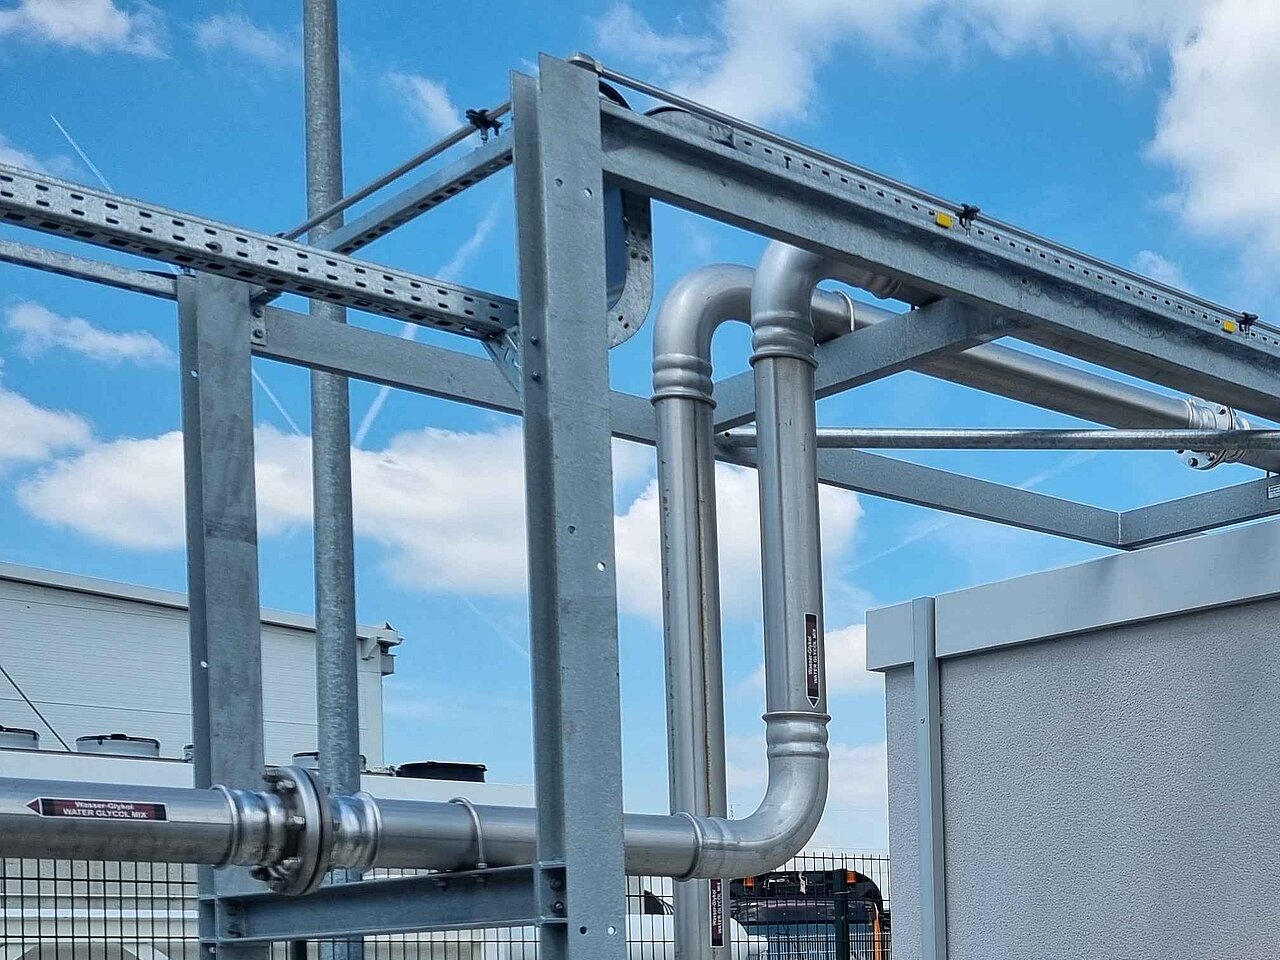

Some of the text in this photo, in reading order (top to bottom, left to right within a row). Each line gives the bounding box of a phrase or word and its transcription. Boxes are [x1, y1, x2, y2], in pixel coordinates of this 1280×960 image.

[74, 801, 135, 811] Wasser-Glykol
[62, 808, 148, 819] WATER GLYCOL MIX
